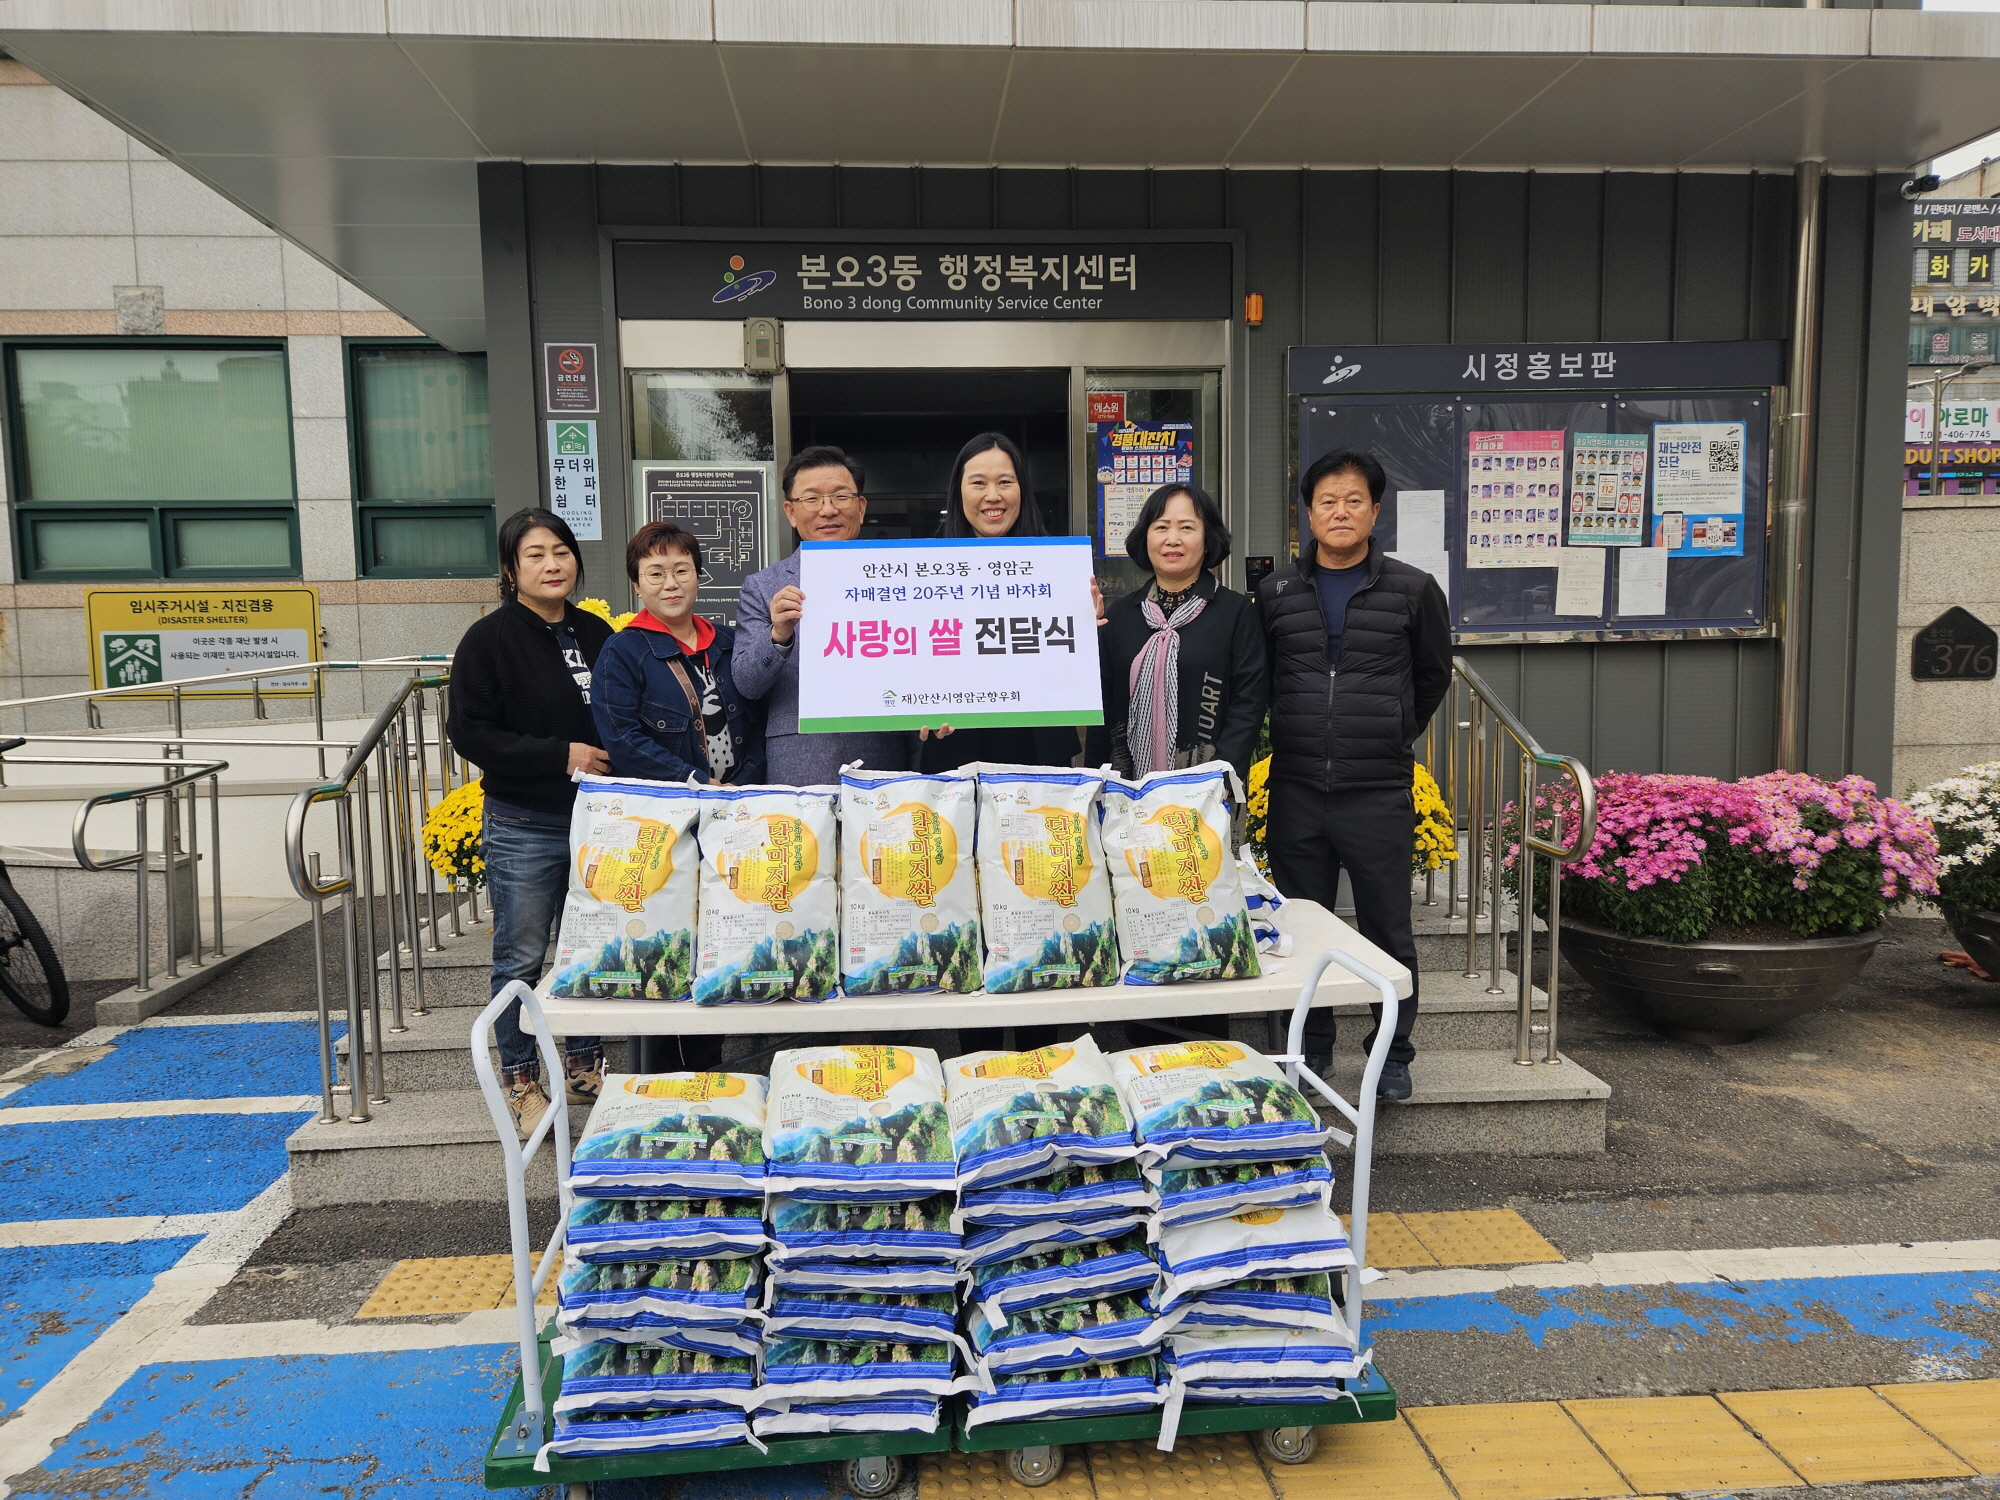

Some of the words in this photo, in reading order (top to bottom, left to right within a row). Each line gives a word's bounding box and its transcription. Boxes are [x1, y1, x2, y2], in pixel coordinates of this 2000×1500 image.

[796, 255, 922, 290] 본오3동
[938, 255, 1137, 291] 행정복지센터
[803, 296, 843, 310] Bono
[848, 296, 857, 310] 3
[862, 296, 901, 313] dong
[906, 296, 993, 313] Community
[997, 296, 1048, 310] Service
[1053, 296, 1103, 310] Center
[1461, 351, 1617, 382] 시정홍보판
[557, 374, 587, 382] 금연건물
[1094, 402, 1119, 413] 에스원
[1112, 430, 1177, 447] 경품대잔치
[1658, 441, 1702, 454] 재난안전
[1954, 447, 2000, 464] SHOP
[553, 458, 595, 472] 무더위
[1658, 456, 1681, 468] 진단
[1658, 469, 1702, 481] 프로젝트
[1601, 485, 1615, 494] 112
[862, 562, 908, 578] 안산시
[914, 561, 971, 578] 본오3동
[987, 560, 1034, 577] 영암군
[844, 585, 907, 602] 자매결연
[912, 584, 964, 600] 20주년
[970, 583, 1000, 600] 기념
[1006, 583, 1052, 599] 바자회
[129, 599, 210, 614] 임시주거시설
[221, 598, 274, 613] 지진겸용
[158, 615, 204, 626] (DISASTER
[206, 615, 248, 625] SHELTER)
[192, 637, 216, 646] 이곳은
[217, 636, 233, 646] 각종
[235, 636, 250, 646] 재난
[252, 636, 269, 646] 발생
[270, 636, 278, 645] 시
[823, 619, 917, 658] 사랑의
[928, 618, 963, 656] 쌀
[975, 616, 1076, 655] 전달식
[169, 651, 201, 660] 사용되는
[202, 651, 226, 660] 이재민
[227, 649, 300, 660] 임시주거시설입니다.
[1931, 644, 1994, 675] 376
[762, 820, 793, 912] 달마지쌀
[906, 810, 937, 908] 달마지쌀
[1045, 815, 1078, 908] 달마지쌀
[1162, 811, 1210, 904] 달마지쌀
